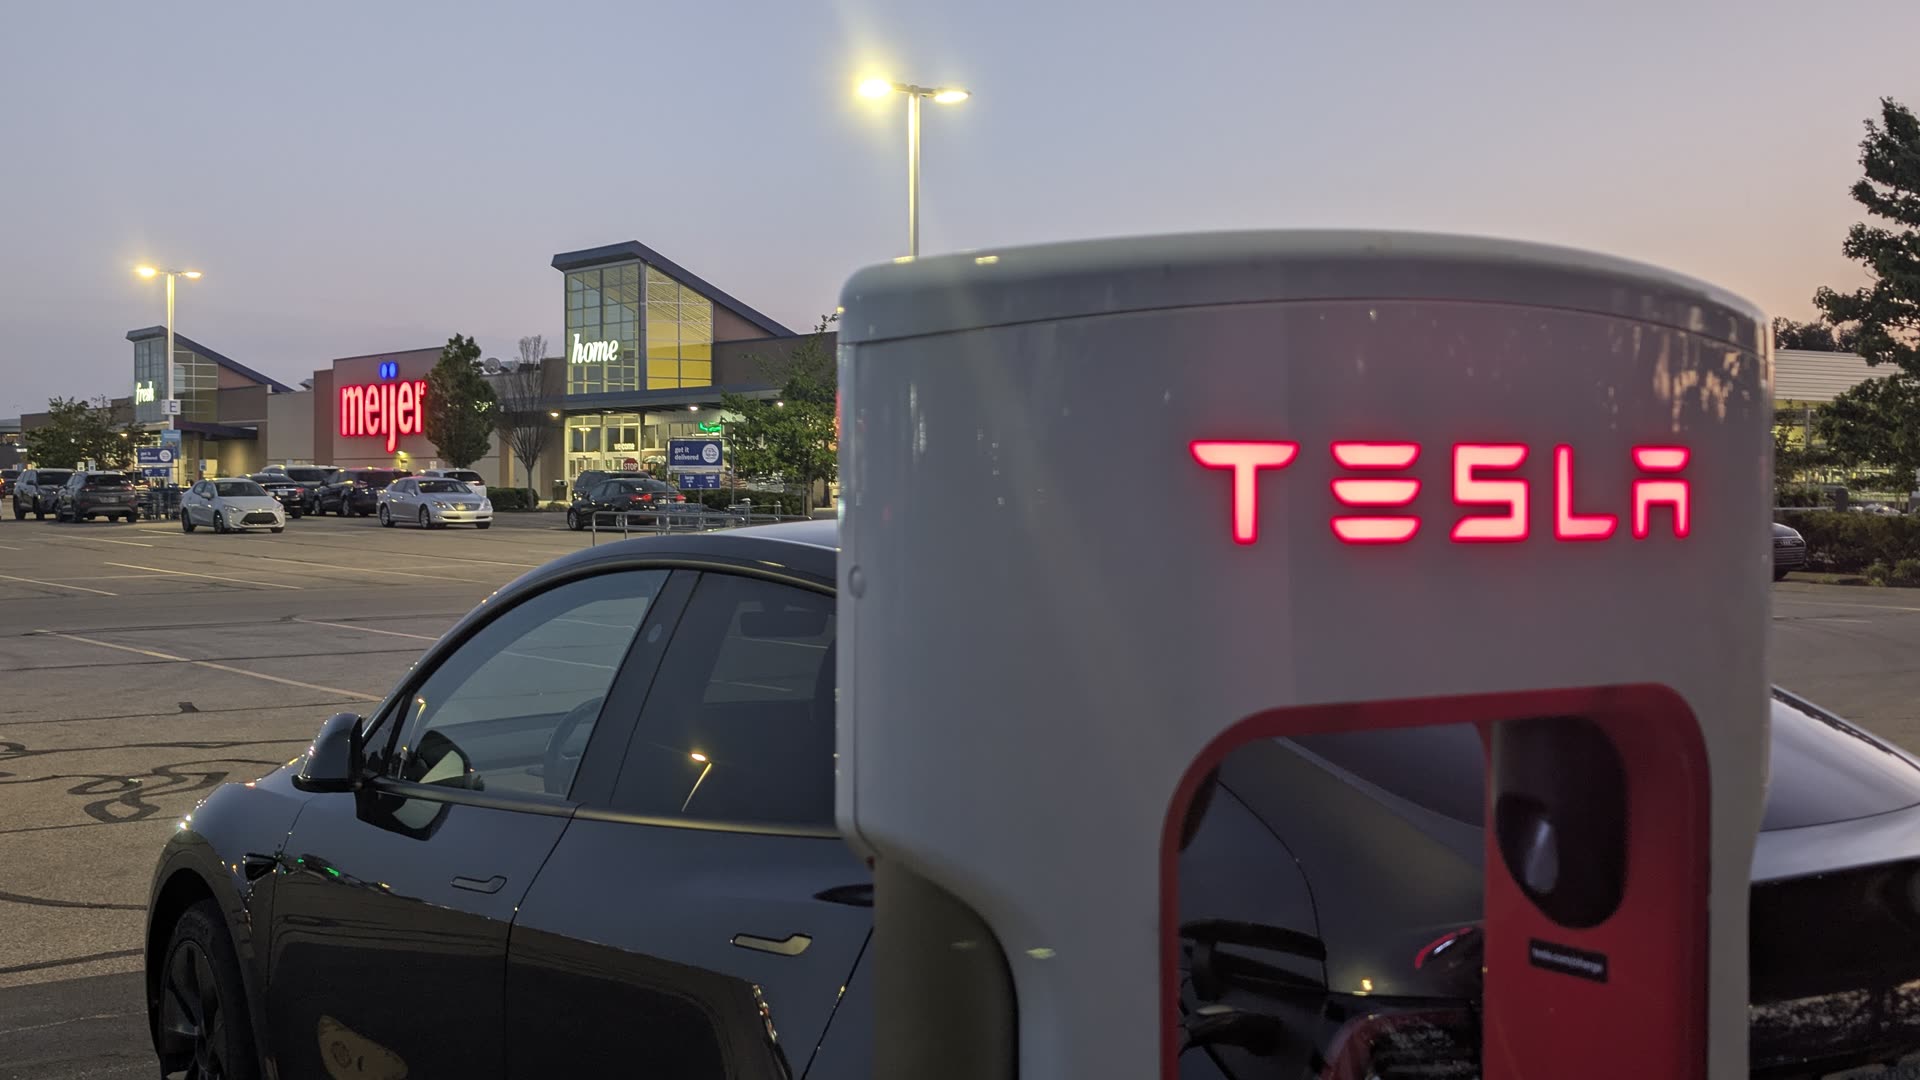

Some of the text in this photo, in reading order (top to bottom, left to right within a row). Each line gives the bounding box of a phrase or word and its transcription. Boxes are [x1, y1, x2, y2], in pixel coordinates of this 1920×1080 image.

[572, 333, 619, 364] home
[136, 381, 154, 405] fresh
[170, 401, 178, 413] E
[340, 362, 427, 453] meijer
[684, 446, 690, 454] it
[623, 462, 638, 471] STOP
[1189, 439, 1691, 545] TESLA
